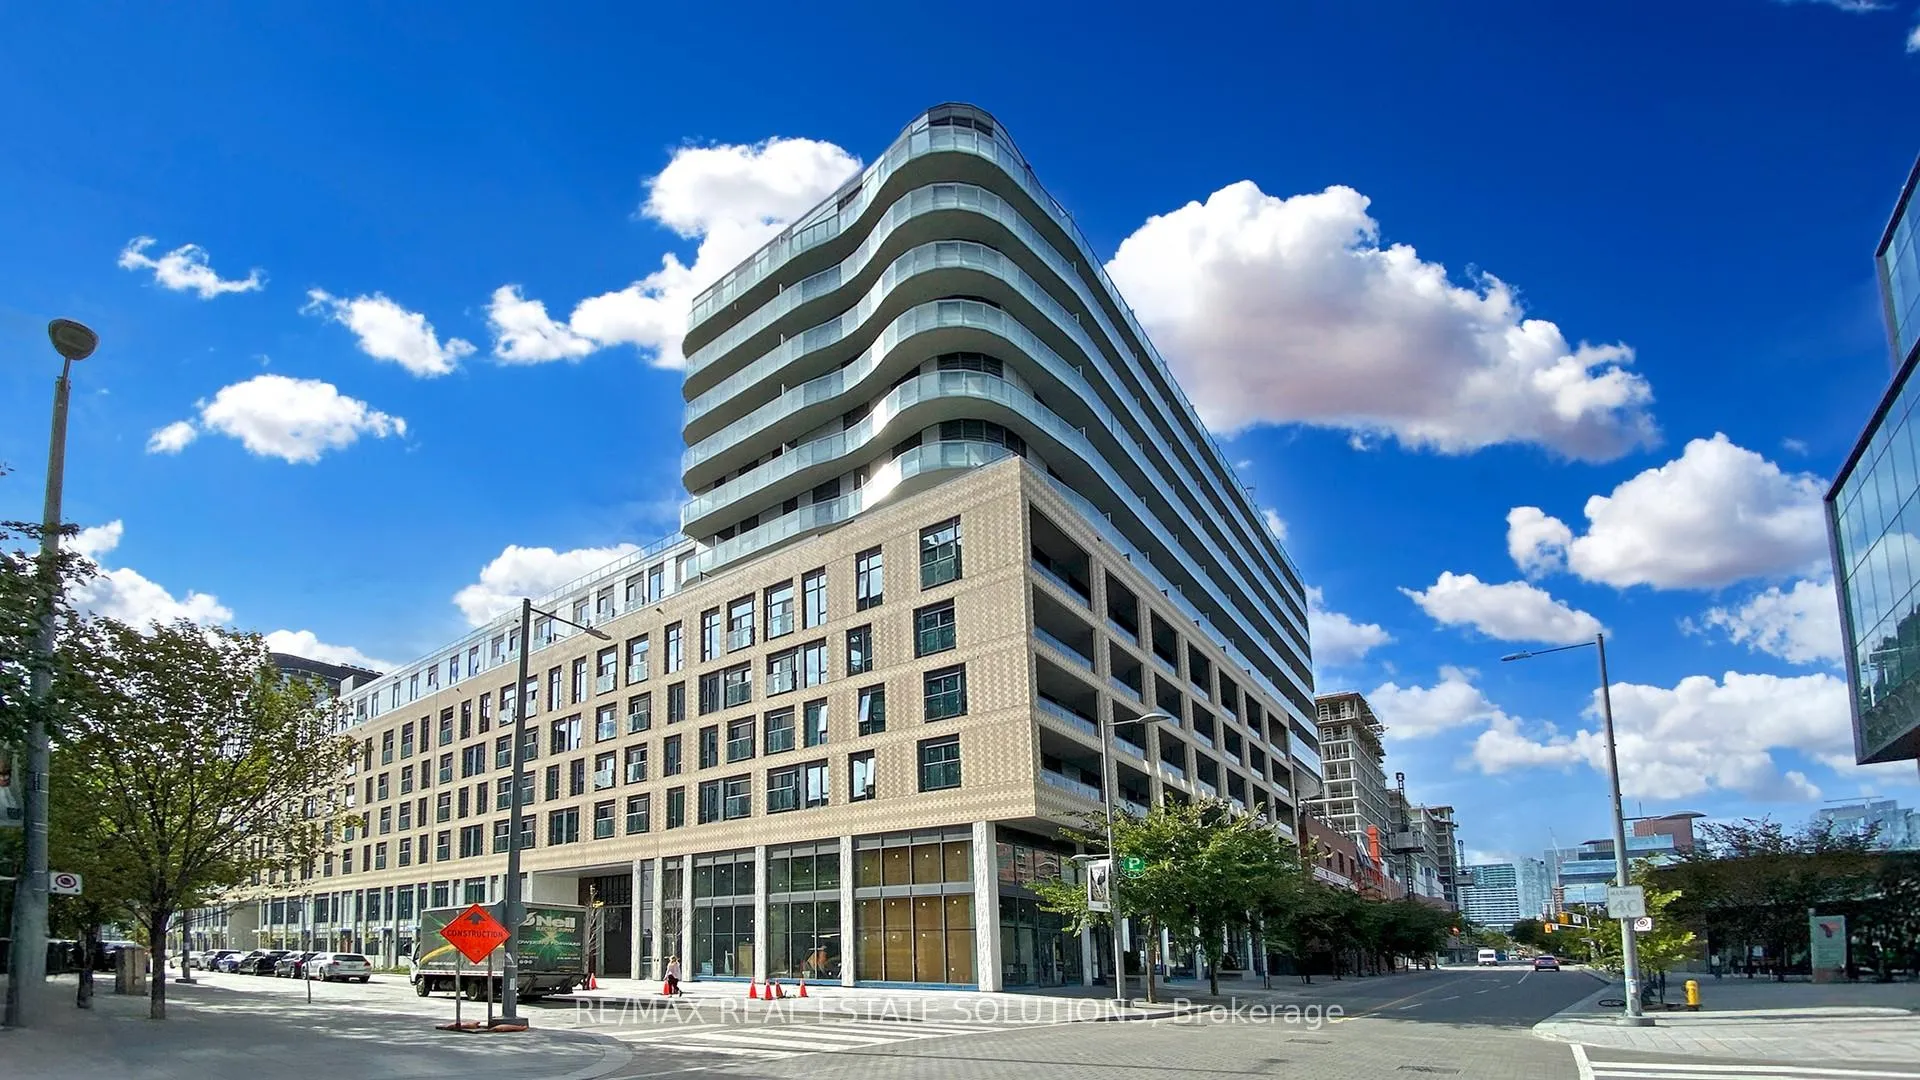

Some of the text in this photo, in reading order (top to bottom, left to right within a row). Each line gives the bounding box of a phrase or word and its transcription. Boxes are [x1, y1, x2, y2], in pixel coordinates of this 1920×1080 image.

[1129, 857, 1141, 869] P
[1612, 899, 1641, 913] 40
[446, 929, 503, 938] CONSTRUCTION
